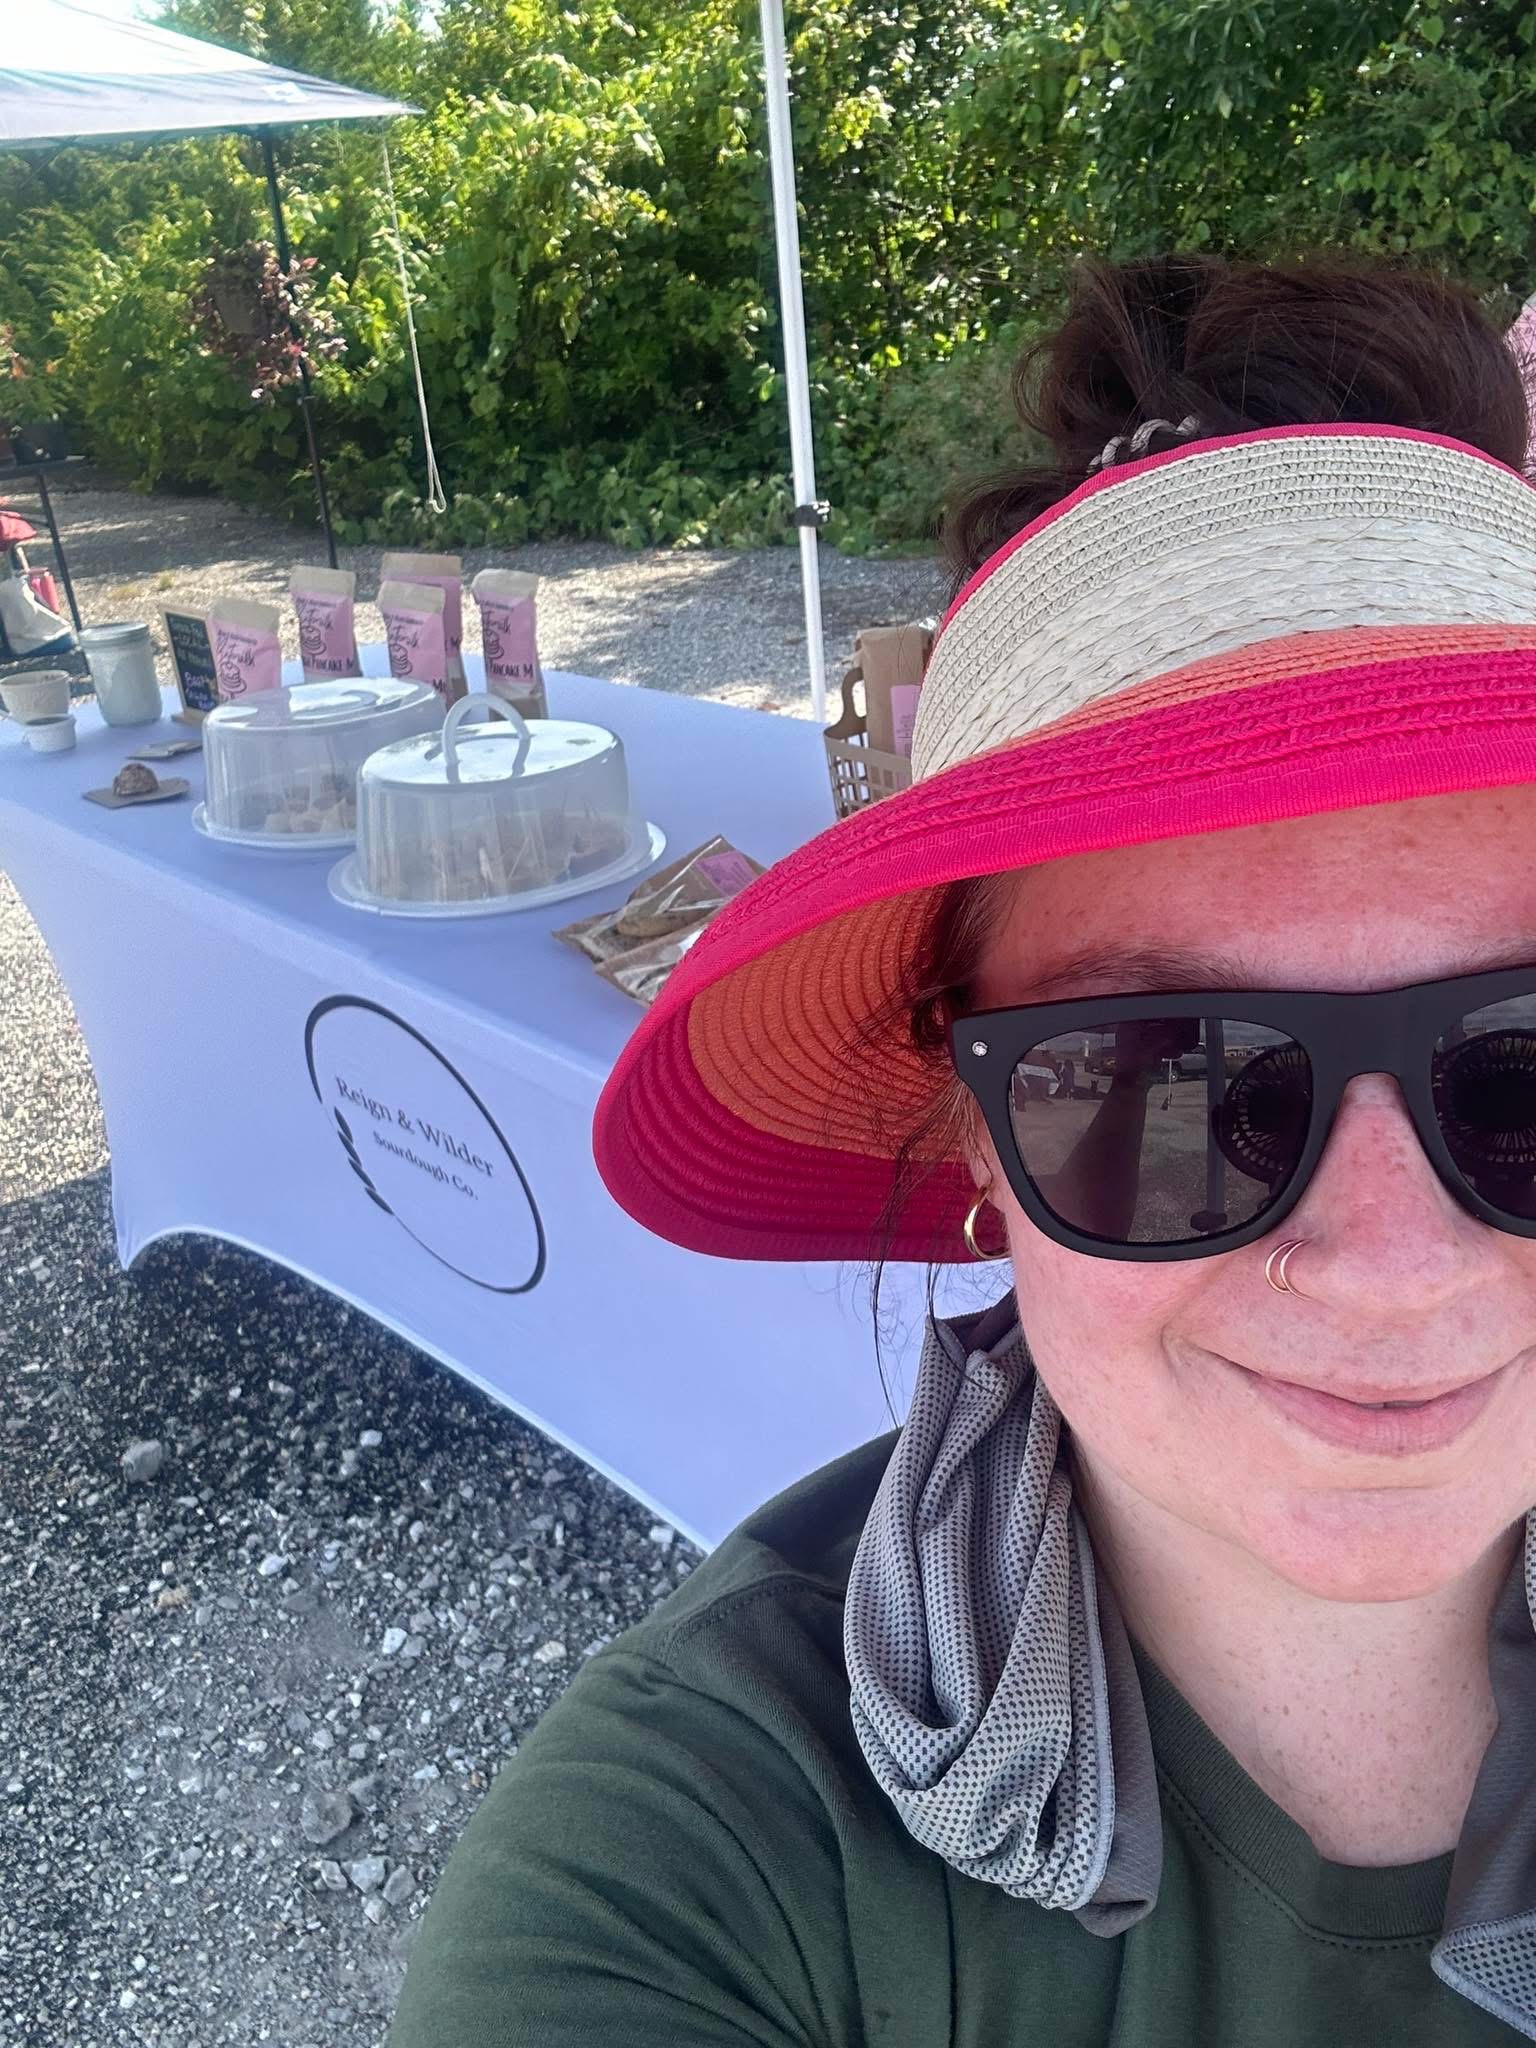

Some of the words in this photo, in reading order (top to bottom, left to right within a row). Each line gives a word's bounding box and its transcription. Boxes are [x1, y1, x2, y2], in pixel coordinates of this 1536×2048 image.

[335, 1076, 393, 1123] Reign
[397, 1109, 416, 1135] &
[416, 1118, 495, 1178] Wilder
[372, 1130, 450, 1183] Sourdough
[452, 1174, 480, 1201] Co.
